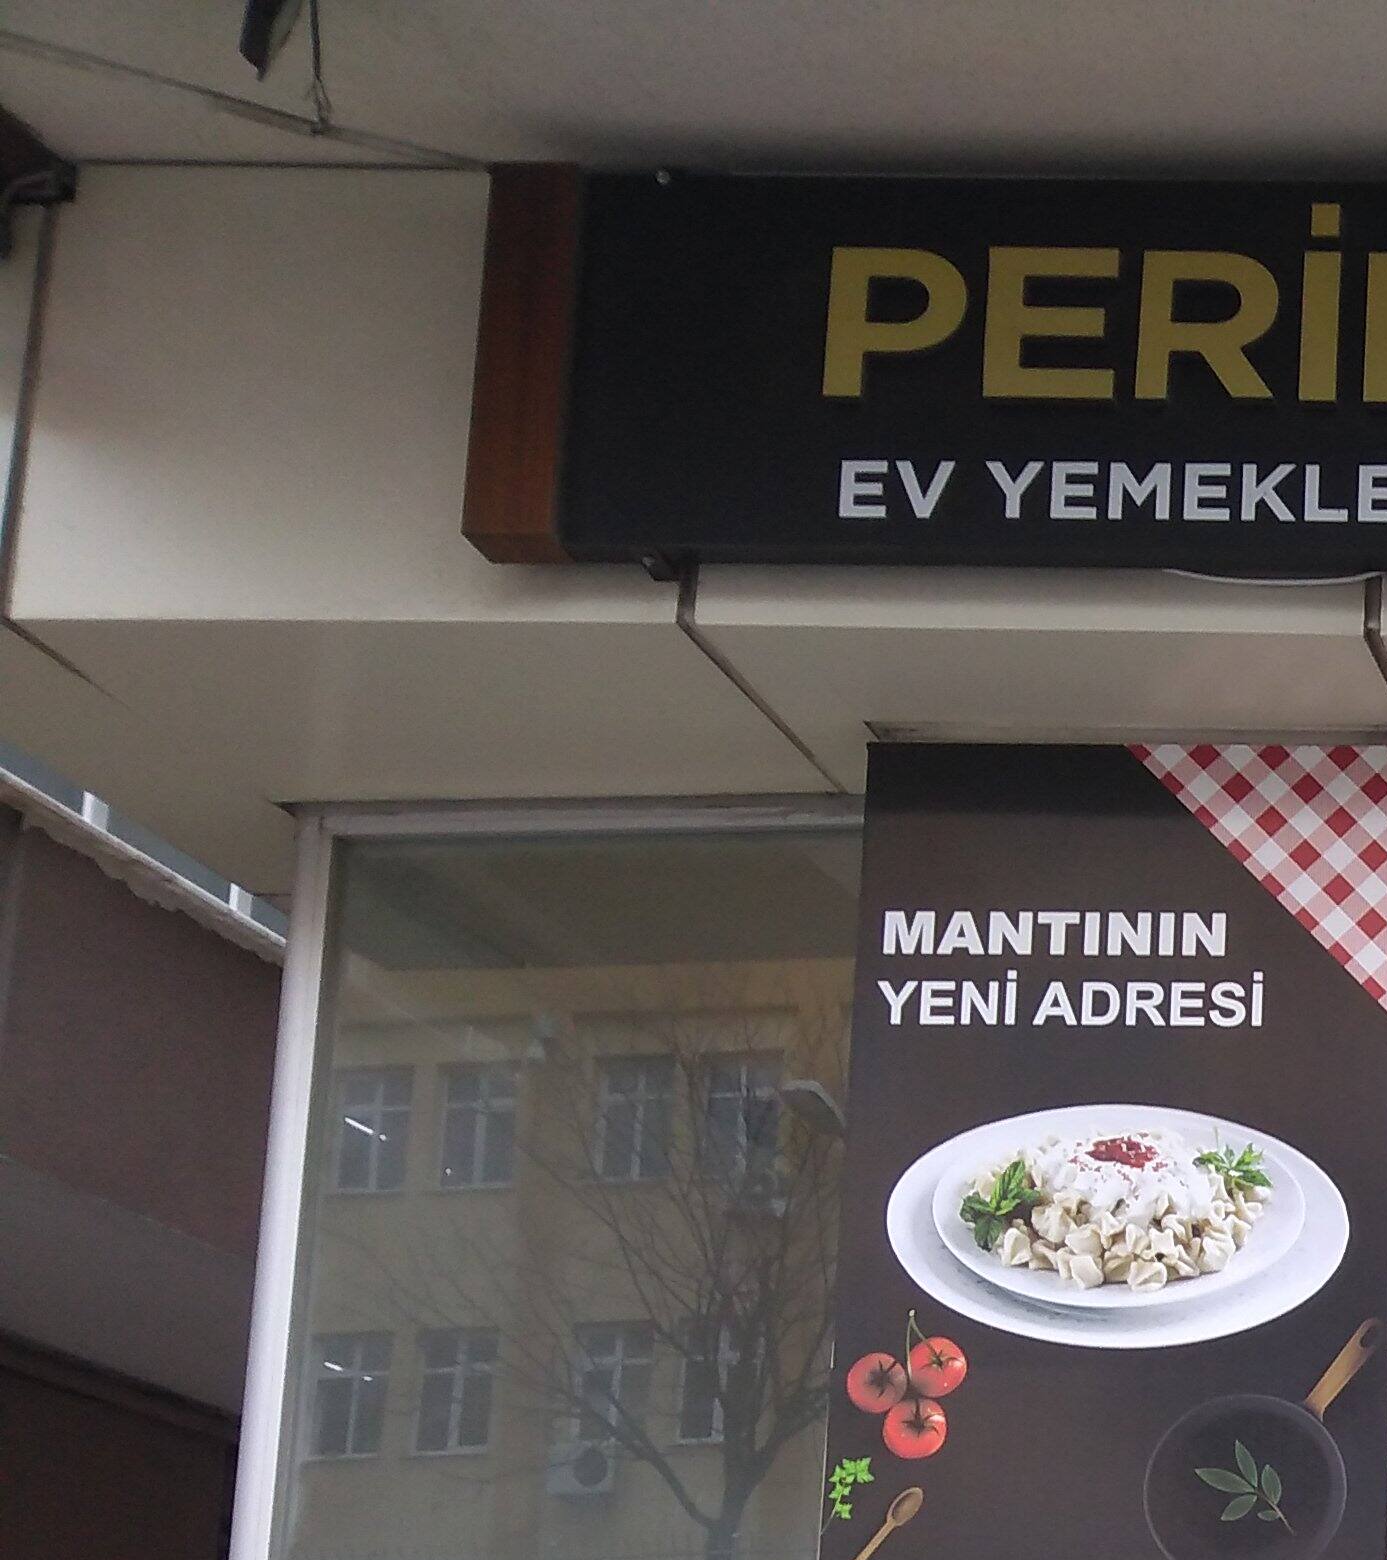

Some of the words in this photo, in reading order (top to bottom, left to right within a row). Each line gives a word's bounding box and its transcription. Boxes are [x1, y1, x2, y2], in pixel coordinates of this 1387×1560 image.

[837, 459, 955, 520] EV
[882, 910, 1228, 957] MANTININ
[877, 970, 1018, 1026] YENİ
[1032, 971, 1264, 1027] ADRESİ
